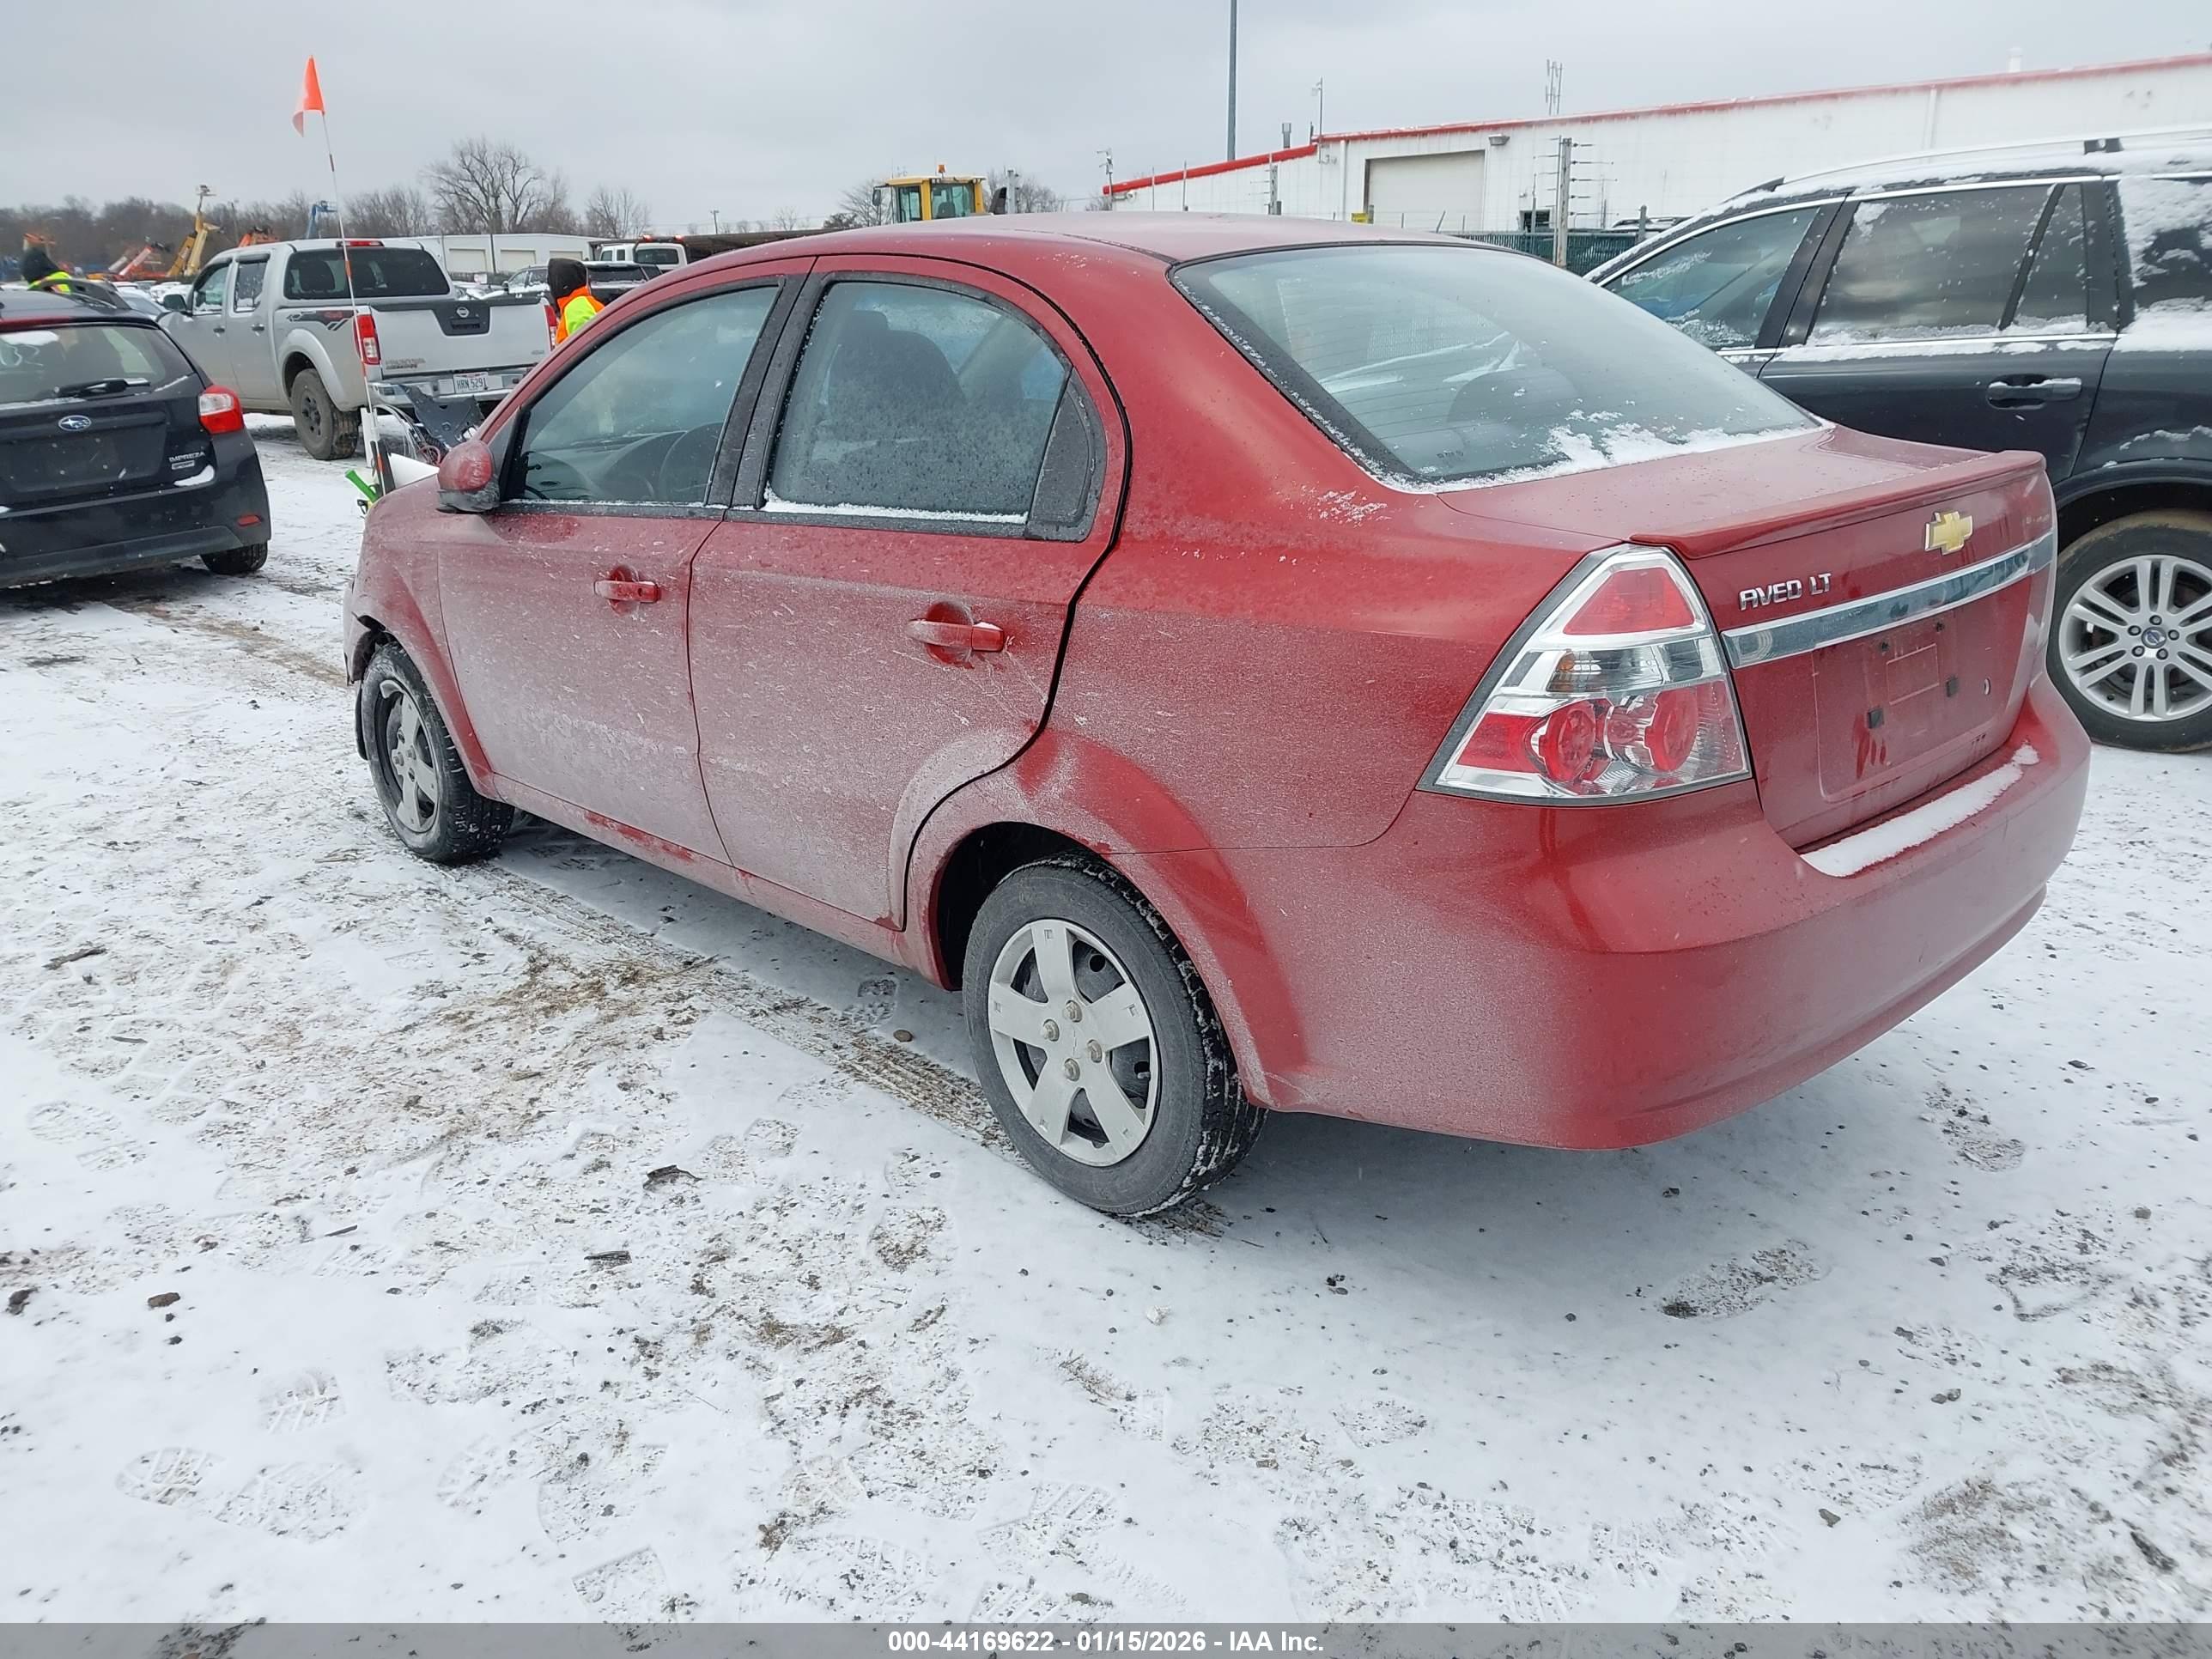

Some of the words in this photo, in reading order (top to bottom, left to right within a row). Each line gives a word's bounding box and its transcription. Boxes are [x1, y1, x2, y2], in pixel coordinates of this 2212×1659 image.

[470, 377, 487, 388] 5291
[169, 452, 206, 462] IMPREZA
[1809, 572, 1832, 596] LT
